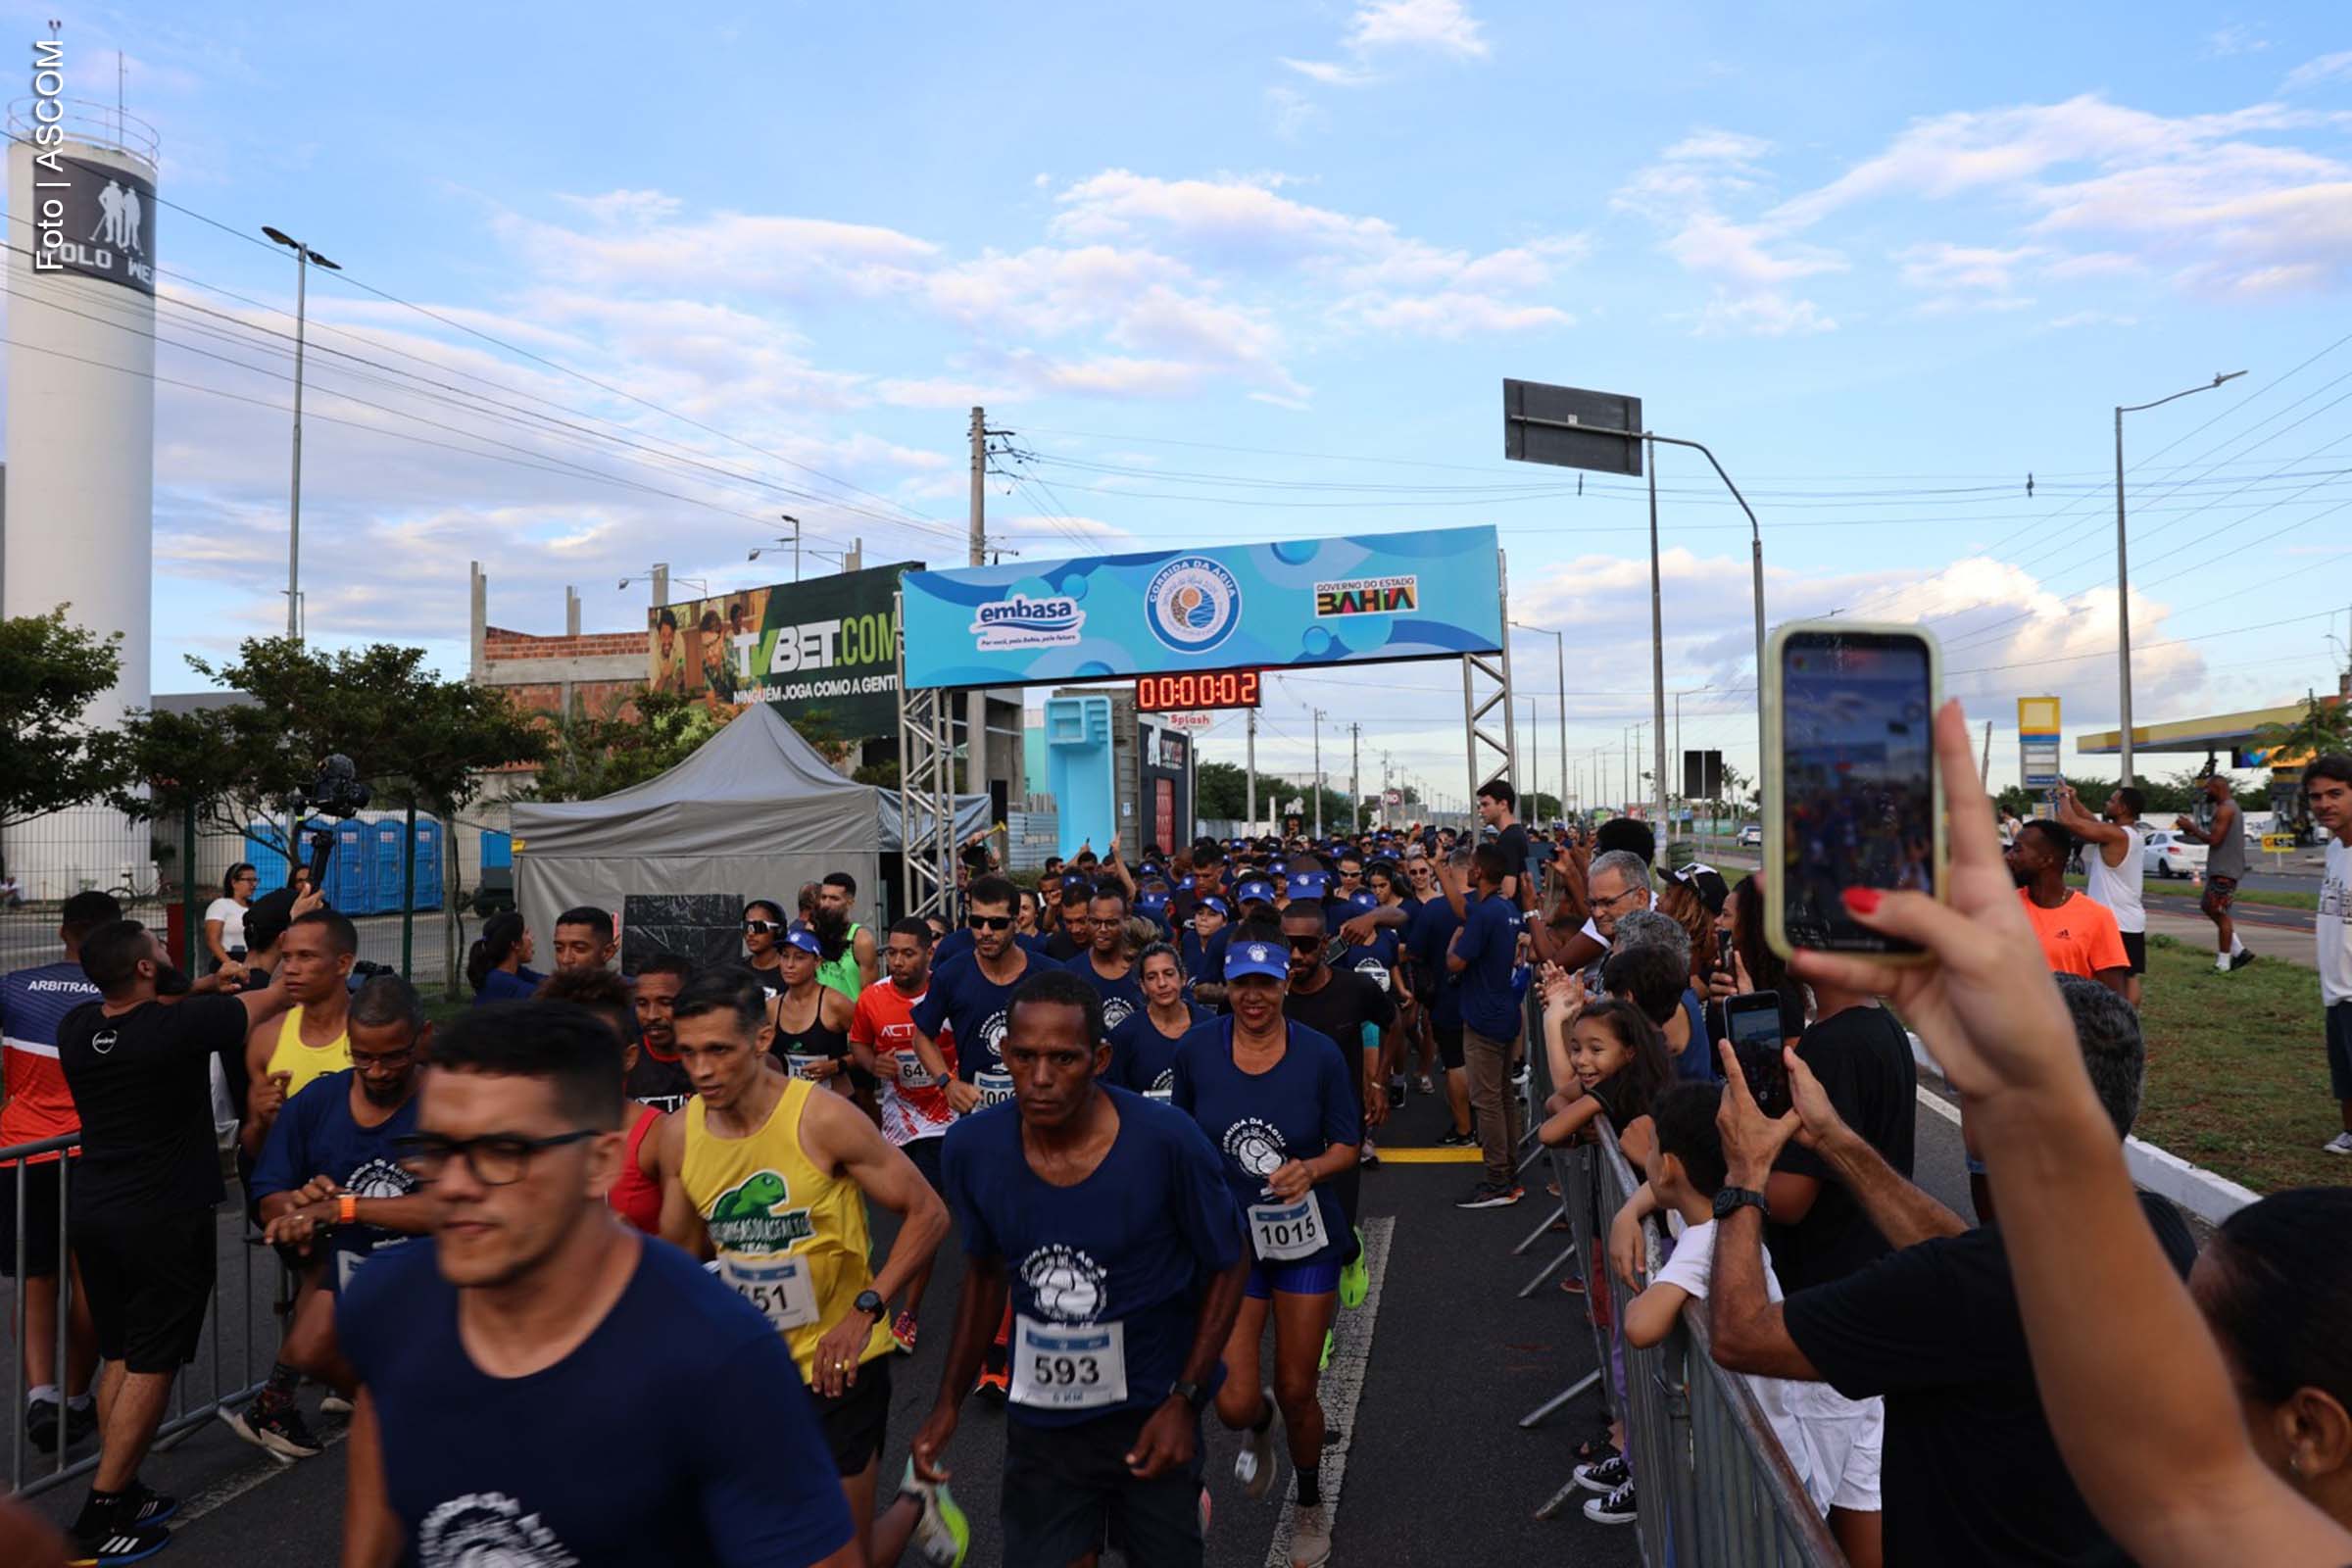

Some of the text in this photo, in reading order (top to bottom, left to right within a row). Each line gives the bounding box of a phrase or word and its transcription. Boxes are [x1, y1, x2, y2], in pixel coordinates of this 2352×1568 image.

[127, 257, 155, 285] WE
[1149, 561, 1190, 604] CORRIDA
[1193, 560, 1209, 569] DA
[1316, 576, 1415, 592] GOVERNO DO ESTADO
[980, 599, 1072, 622] embasa
[733, 674, 898, 706] NINGUÉM JOGA COMO A GENT
[1139, 672, 1257, 708] 00:00:02
[1170, 713, 1209, 725] Splash
[27, 980, 101, 995] ARBITRAG
[903, 1063, 931, 1078] 64
[1249, 1117, 1263, 1126] DA
[1259, 1214, 1316, 1246] 1015
[1034, 1354, 1100, 1386] 593
